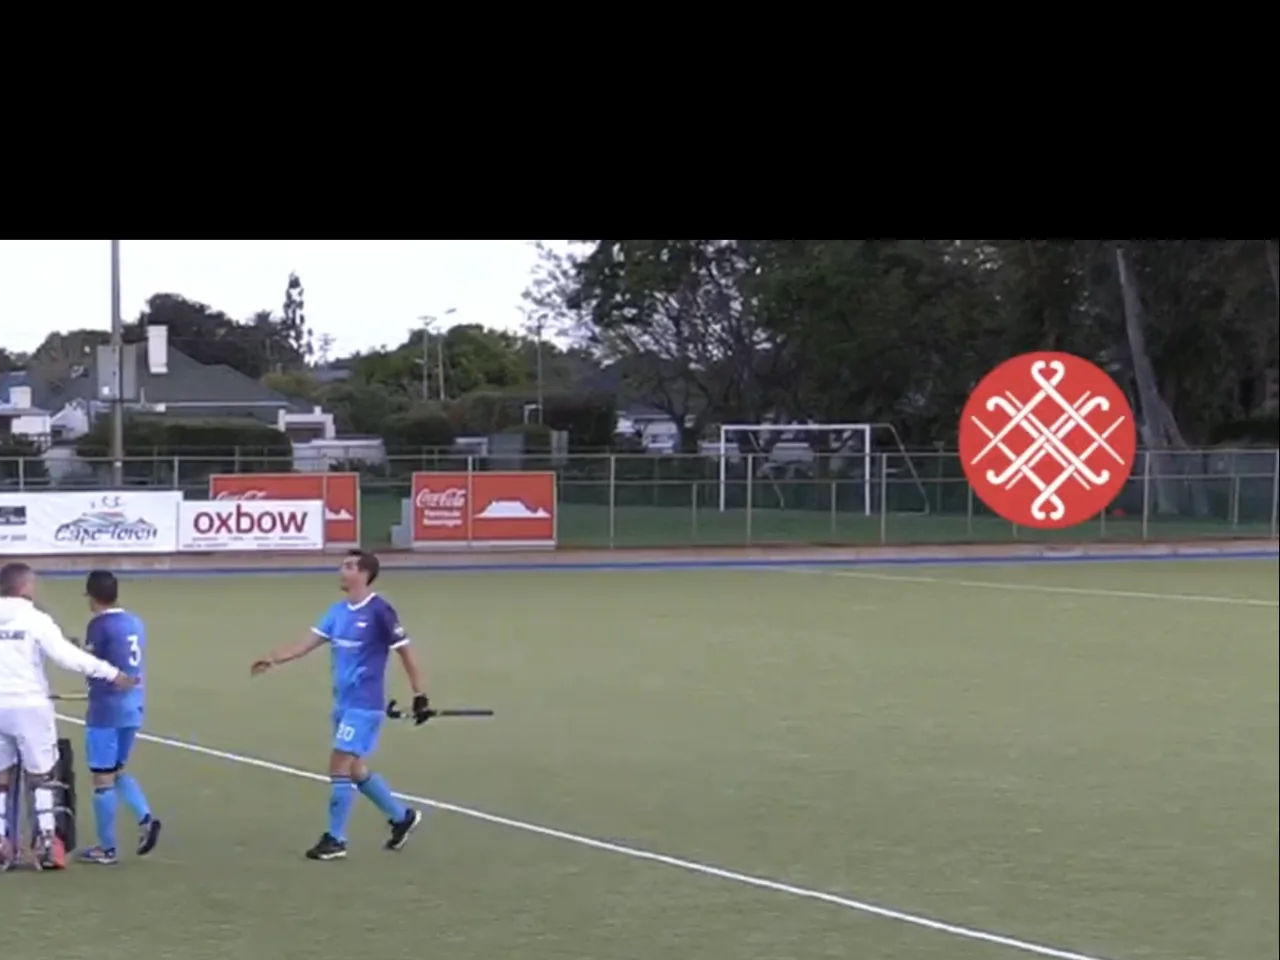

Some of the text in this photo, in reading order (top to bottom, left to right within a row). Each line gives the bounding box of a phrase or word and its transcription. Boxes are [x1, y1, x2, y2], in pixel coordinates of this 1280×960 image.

[55, 521, 157, 546] Cape Town
[193, 503, 308, 534] oxbow
[128, 634, 141, 667] 3
